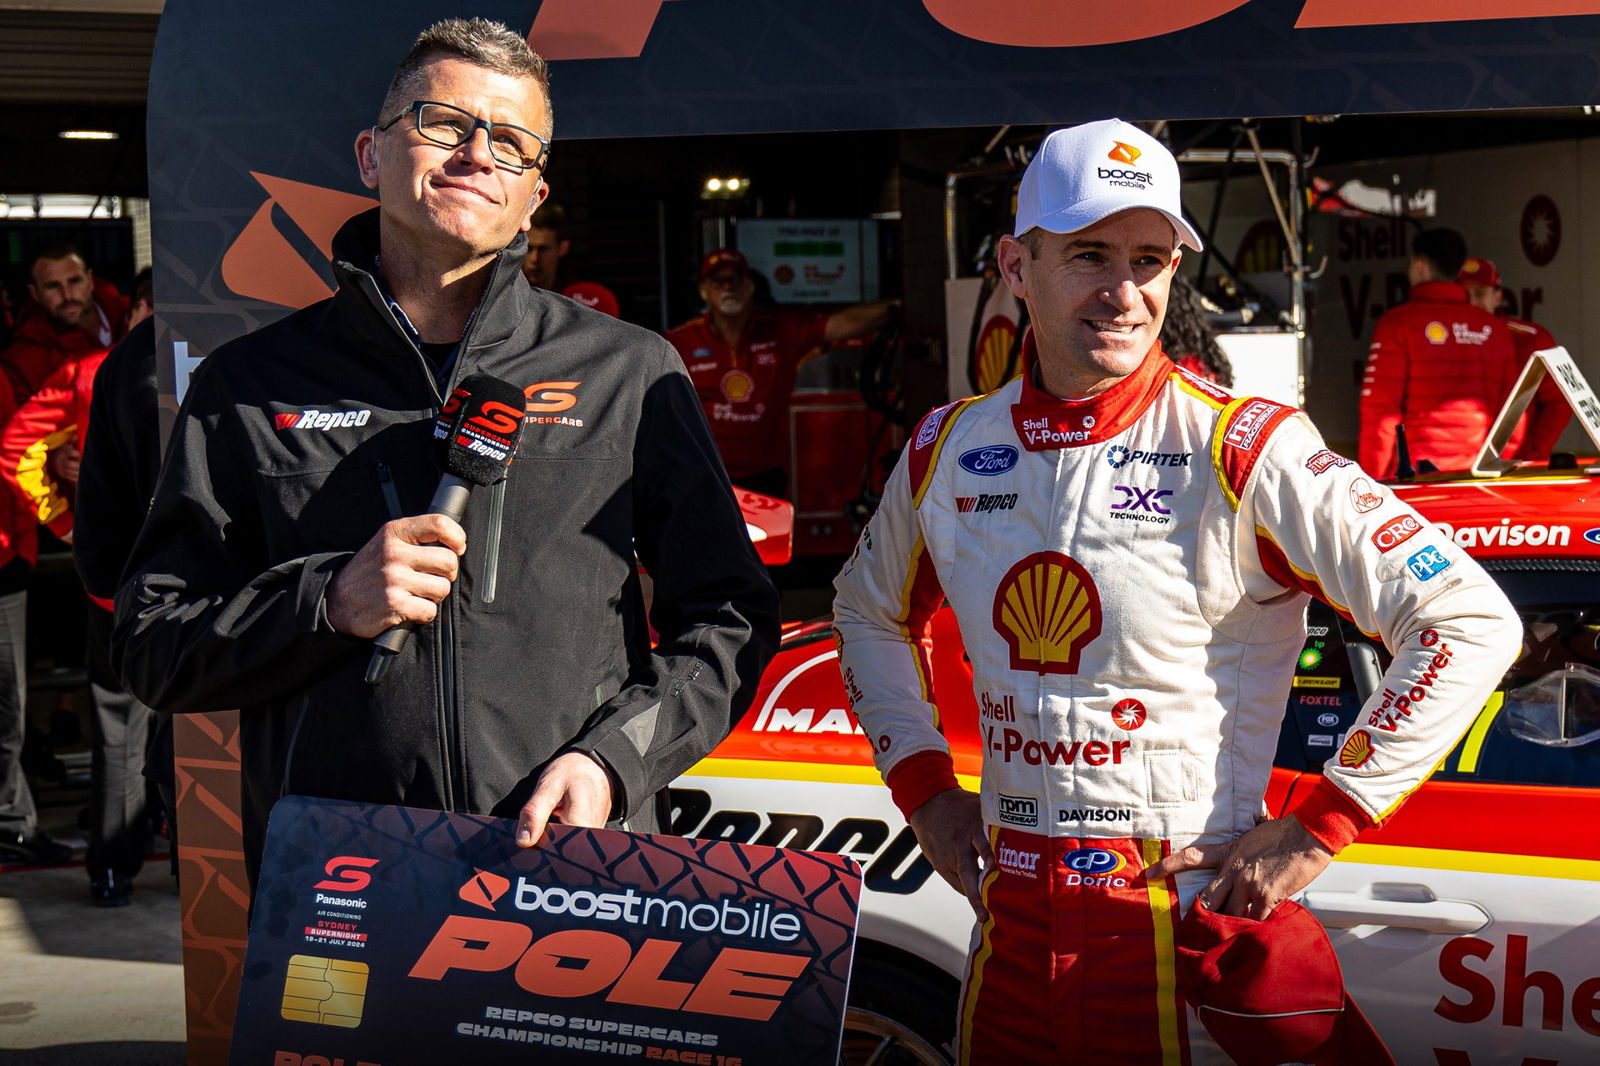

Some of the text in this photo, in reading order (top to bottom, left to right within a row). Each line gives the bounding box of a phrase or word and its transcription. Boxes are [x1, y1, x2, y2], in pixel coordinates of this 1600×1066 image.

[1097, 167, 1153, 186] boost
[1109, 180, 1146, 190] mobile
[295, 409, 371, 431] Repco
[1023, 417, 1049, 431] Shell
[1228, 402, 1269, 442] rpm
[1025, 429, 1091, 446] V-Power
[467, 439, 508, 461] Repco
[974, 449, 1010, 470] Ford
[1130, 450, 1193, 467] PIRTEK
[975, 493, 1018, 513] Repco
[1109, 511, 1171, 525] TECHNOLOGY
[1376, 516, 1420, 548] CRC
[1410, 549, 1446, 577] PPG
[1314, 640, 1325, 649] bp
[845, 667, 864, 704] Shell
[1378, 642, 1454, 733] V-Power
[982, 692, 1017, 723] Shell
[1300, 695, 1342, 706] FOXTEL
[1368, 688, 1397, 728] Shell
[1001, 798, 1035, 815] rpm
[1059, 808, 1131, 823] DAVISON
[998, 841, 1041, 871] imar
[1066, 874, 1126, 888] Doric
[316, 893, 367, 908] Panasonic
[326, 911, 361, 920] CONDITIONING
[310, 928, 361, 940] SUPERNIGHT
[317, 920, 357, 931] SYDNEY
[329, 938, 346, 946] JULY
[347, 940, 365, 948] 2024
[408, 914, 812, 1022] POLE
[486, 1006, 719, 1047] REPCO SUPERCARS
[456, 1022, 643, 1057] CHAMPIONSHIP
[645, 1046, 713, 1066] RACE
